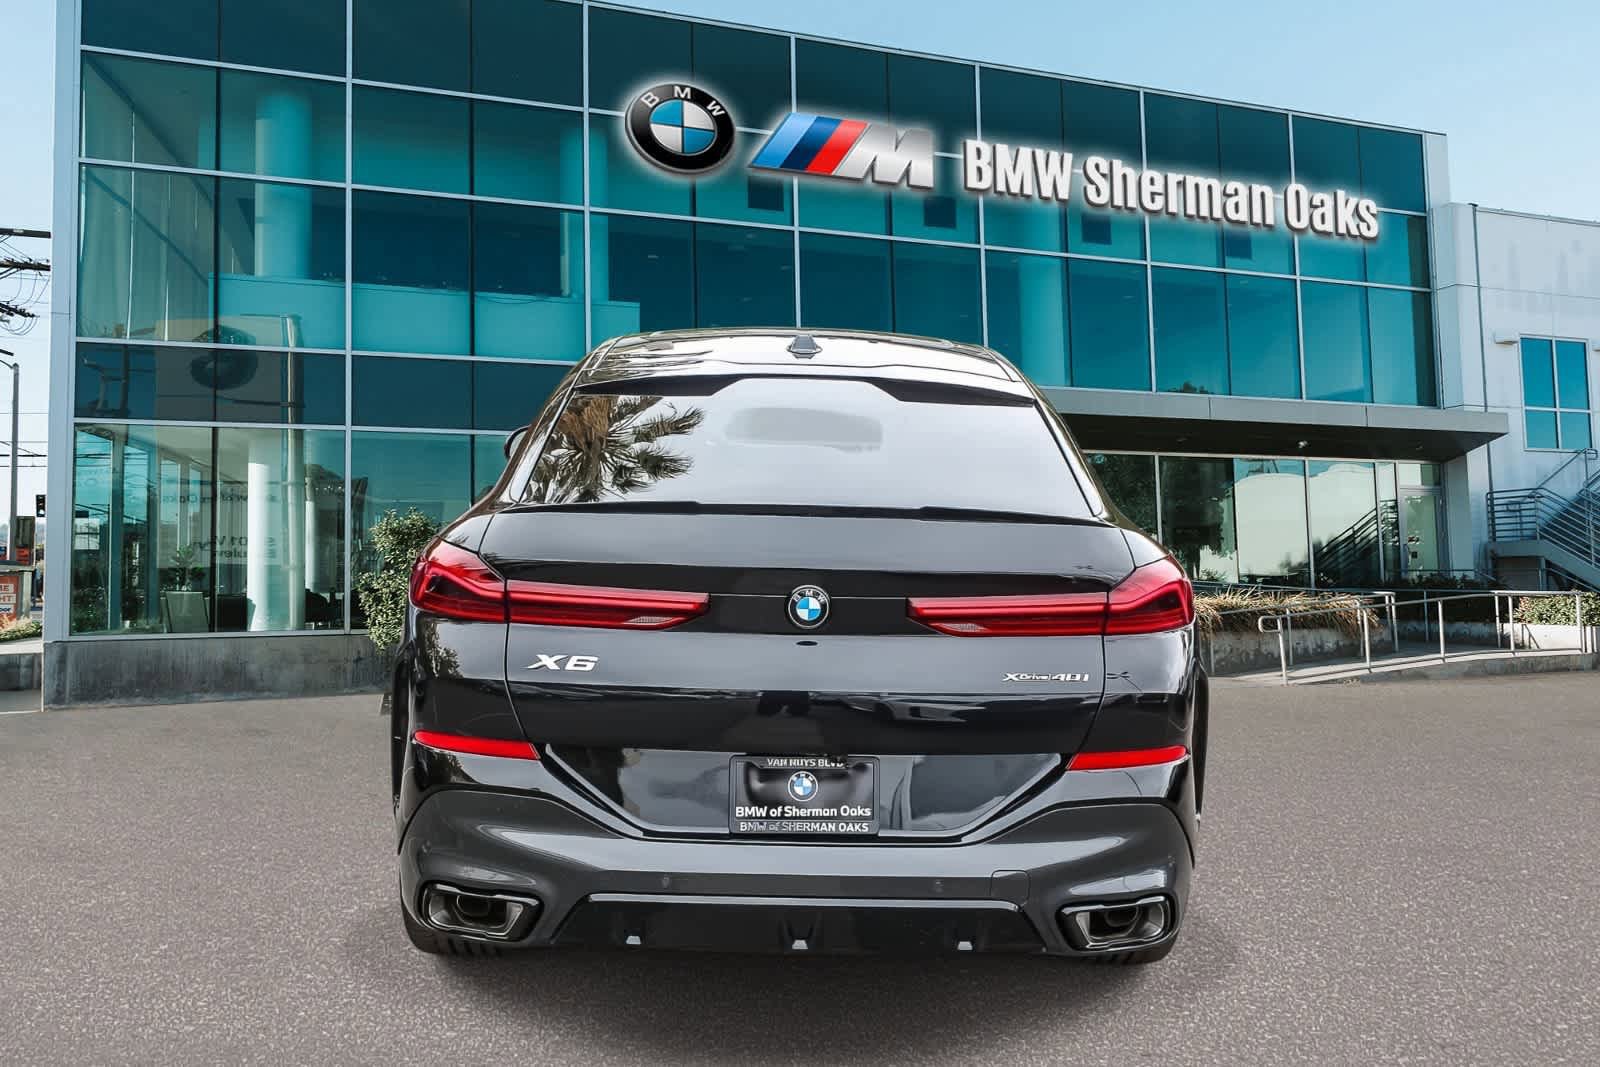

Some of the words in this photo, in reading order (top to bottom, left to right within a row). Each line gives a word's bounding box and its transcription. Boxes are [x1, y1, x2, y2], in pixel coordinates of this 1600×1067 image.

[641, 85, 726, 117] BMW
[963, 138, 1073, 202] BMW
[1083, 155, 1276, 229] Sherman
[1284, 182, 1380, 240] Oaks
[526, 654, 599, 671] X6
[767, 758, 788, 767] VAN
[789, 758, 816, 767] NUYS
[735, 806, 768, 817] BMW
[769, 806, 783, 817] of
[784, 805, 838, 817] Sherman
[840, 805, 872, 817] Oaks
[740, 822, 768, 832] BMW
[781, 822, 836, 832] SHERMAN
[838, 822, 869, 832] OAKS
